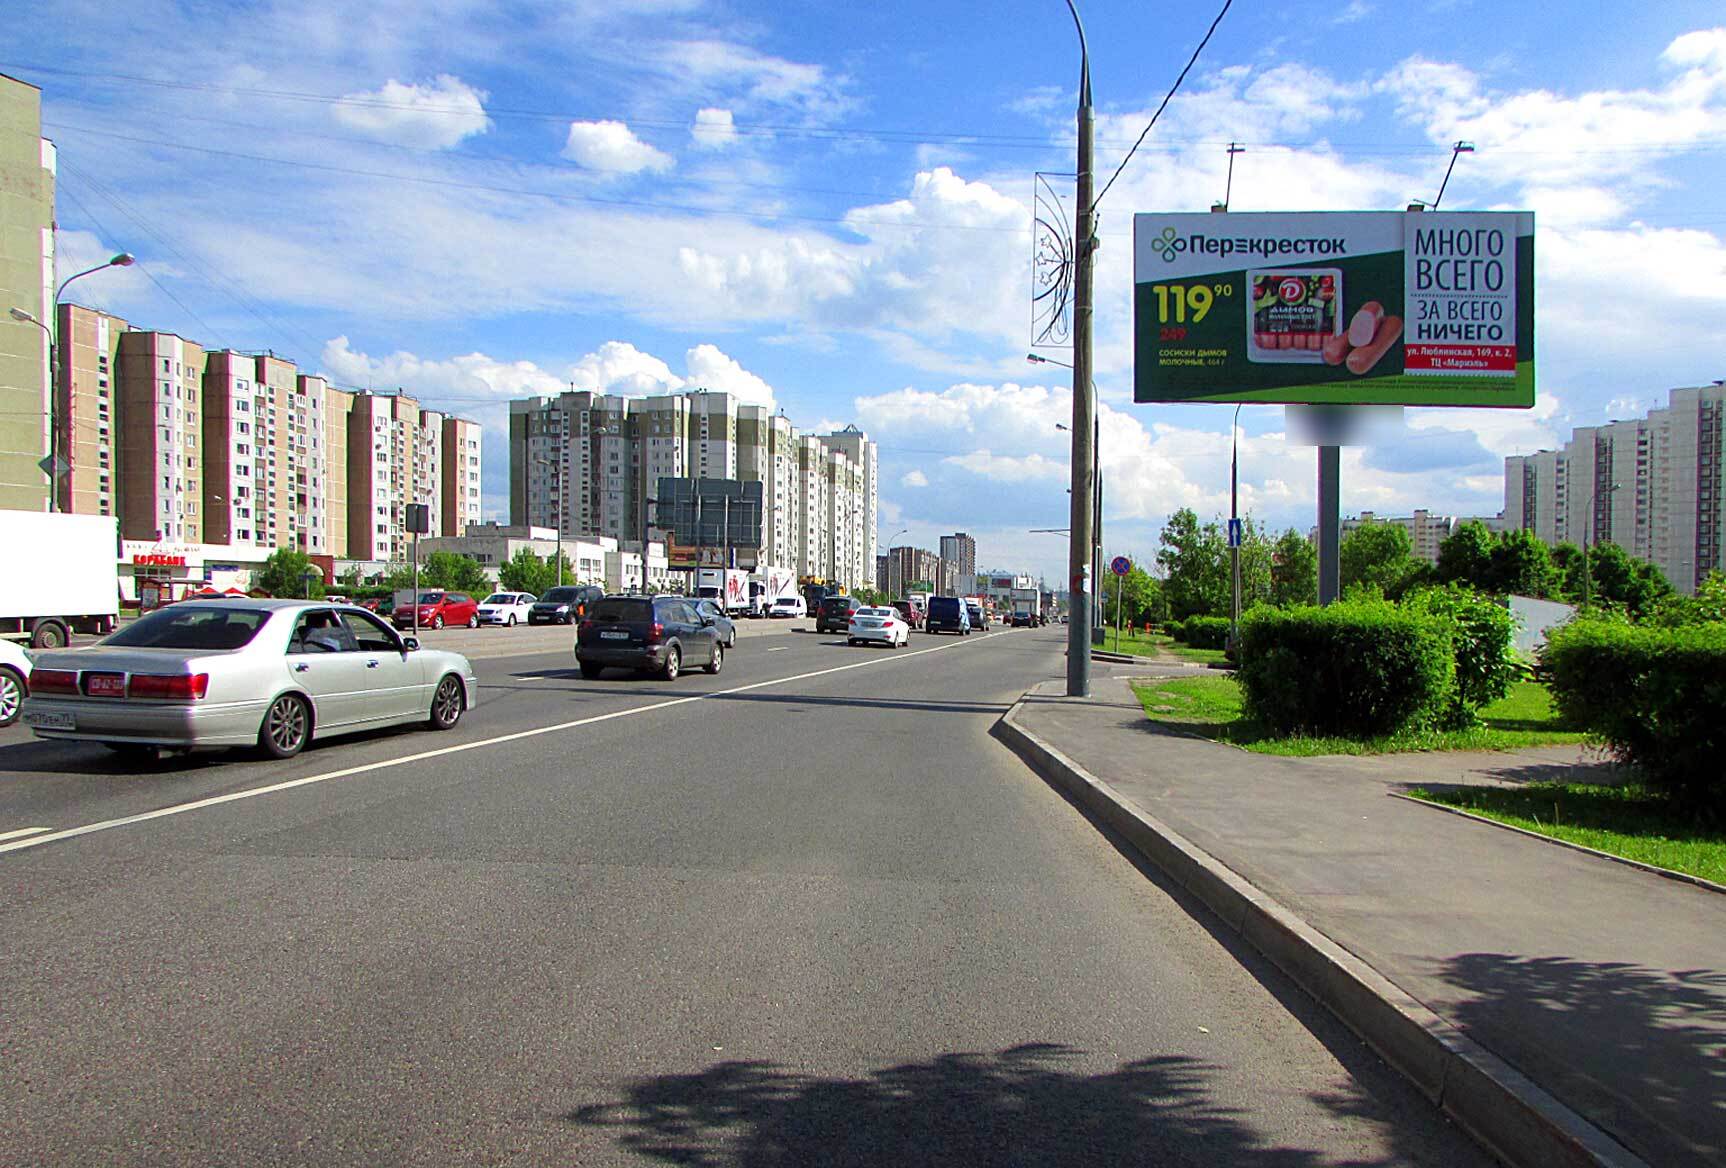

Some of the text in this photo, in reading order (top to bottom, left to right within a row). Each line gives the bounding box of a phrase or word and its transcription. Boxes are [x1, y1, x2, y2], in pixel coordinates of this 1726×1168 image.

[1190, 235, 1346, 258] Перекресток
[1415, 229, 1504, 256] МНОГО
[1416, 259, 1504, 291] ВСЕГО
[1152, 284, 1232, 323] 119 90
[1417, 300, 1503, 321] ЗА ВСЕГО
[1417, 323, 1503, 341] НИЧЕГО
[1159, 349, 1195, 357] СОСИСКИ
[1407, 348, 1419, 357] ул.
[1431, 358, 1441, 368] ТЦ
